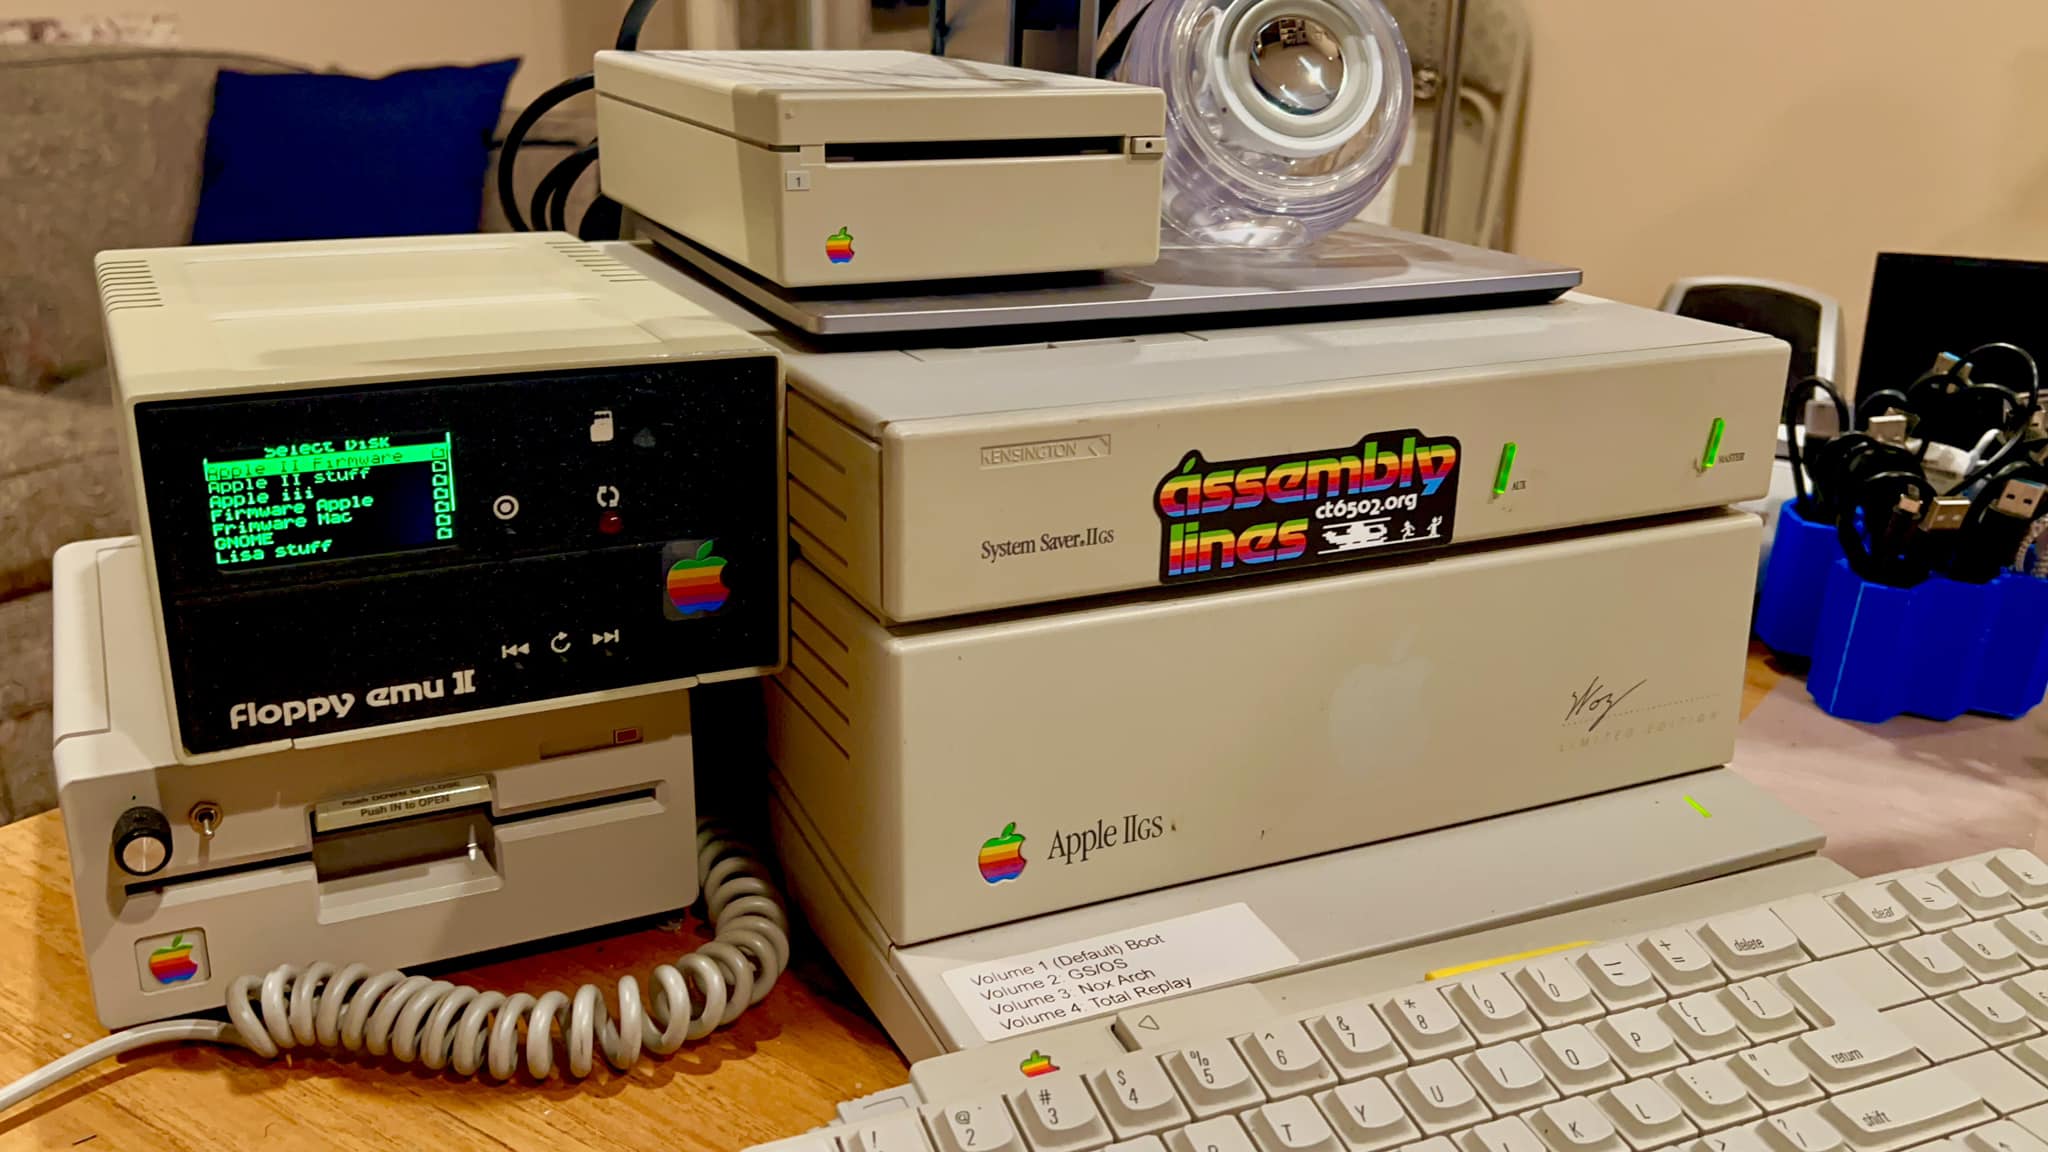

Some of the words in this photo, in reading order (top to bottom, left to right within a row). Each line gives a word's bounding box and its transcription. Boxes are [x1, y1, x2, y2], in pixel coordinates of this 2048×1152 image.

[981, 441, 1078, 465] KENSINGTON
[207, 463, 266, 481] Apple
[280, 460, 299, 474] II
[312, 452, 404, 471] Firmware
[1159, 436, 1457, 518] assembly
[208, 477, 268, 494] Apple
[281, 474, 301, 487] II
[314, 467, 371, 484] stuff
[209, 491, 270, 509] Apple
[282, 486, 315, 502] iii
[1314, 493, 1418, 520] ct6502.org
[211, 501, 306, 522] Firmware
[316, 495, 374, 513] Apple
[212, 515, 307, 537] Frimware
[317, 511, 353, 526] Mac
[214, 532, 275, 551] GNOME
[215, 548, 265, 565] Lisa
[275, 539, 333, 558] stuff
[981, 538, 1036, 563] System
[1168, 518, 1309, 577] lines
[229, 693, 356, 731] floppy
[365, 678, 445, 708] emu
[451, 669, 476, 695] II
[360, 804, 387, 817] Push
[390, 802, 402, 812] IN
[405, 799, 416, 810] to
[418, 794, 451, 808] OPEN
[1047, 819, 1118, 865] Apple
[1733, 937, 1765, 951] delete
[970, 965, 1034, 987] Volume
[1052, 944, 1124, 968] (Default)
[1125, 933, 1165, 951] Boot
[980, 979, 1045, 1001] Volume
[1068, 958, 1128, 980] GS/OS
[989, 994, 1056, 1016] Volume
[1078, 980, 1115, 996] Nox
[1117, 966, 1157, 986] Arch
[999, 1008, 1067, 1031] Volume
[1089, 990, 1132, 1009] Total
[1135, 975, 1193, 999] Replay
[1484, 999, 1496, 1014] 9
[1416, 1014, 1429, 1030] 8
[1346, 1032, 1357, 1047] 7
[1630, 1032, 1641, 1048] P
[1276, 1049, 1288, 1066] 6
[1831, 1048, 1864, 1064] return
[1203, 1067, 1215, 1085] 5
[1128, 1087, 1139, 1104] 4
[1430, 1085, 1444, 1103] U
[1047, 1107, 1059, 1125] 3
[1354, 1105, 1367, 1122] Y
[1635, 1103, 1651, 1120] L
[1861, 1109, 1891, 1128] shift
[965, 1128, 977, 1147] 2
[1281, 1124, 1292, 1142] T
[1567, 1121, 1585, 1139] K
